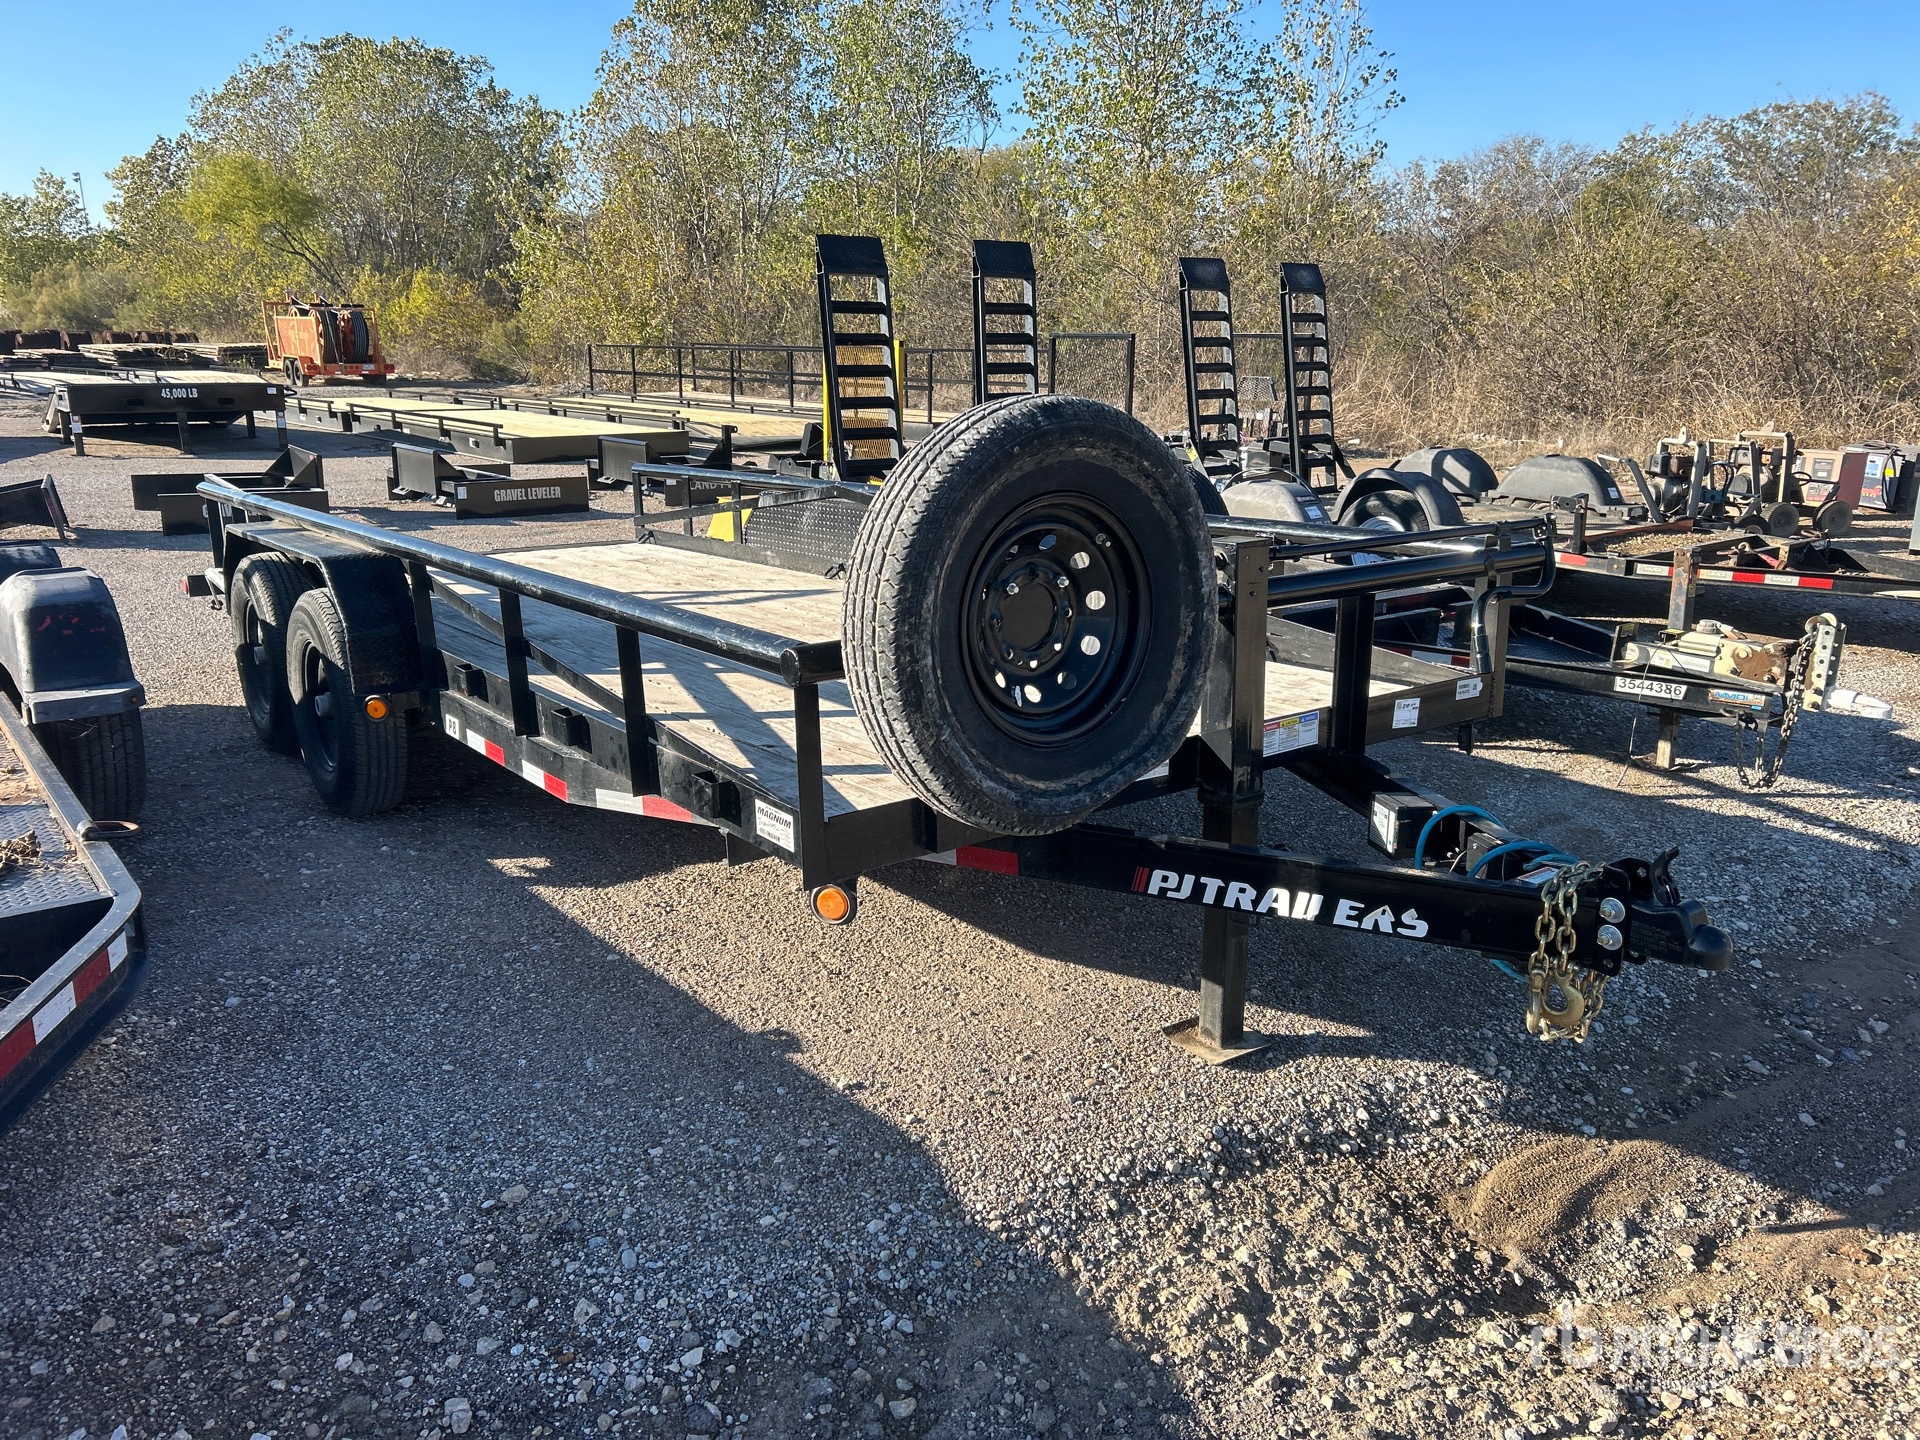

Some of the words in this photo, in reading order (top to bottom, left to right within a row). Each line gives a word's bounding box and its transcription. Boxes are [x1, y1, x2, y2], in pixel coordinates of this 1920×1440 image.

[161, 388, 187, 400] 45,000
[187, 387, 198, 398] LB
[494, 488, 527, 502] GRAVEL
[528, 486, 561, 500] LEVELER
[1618, 678, 1682, 696] 3544386
[757, 806, 792, 829] MAGNUM
[1147, 869, 1195, 899] PJ
